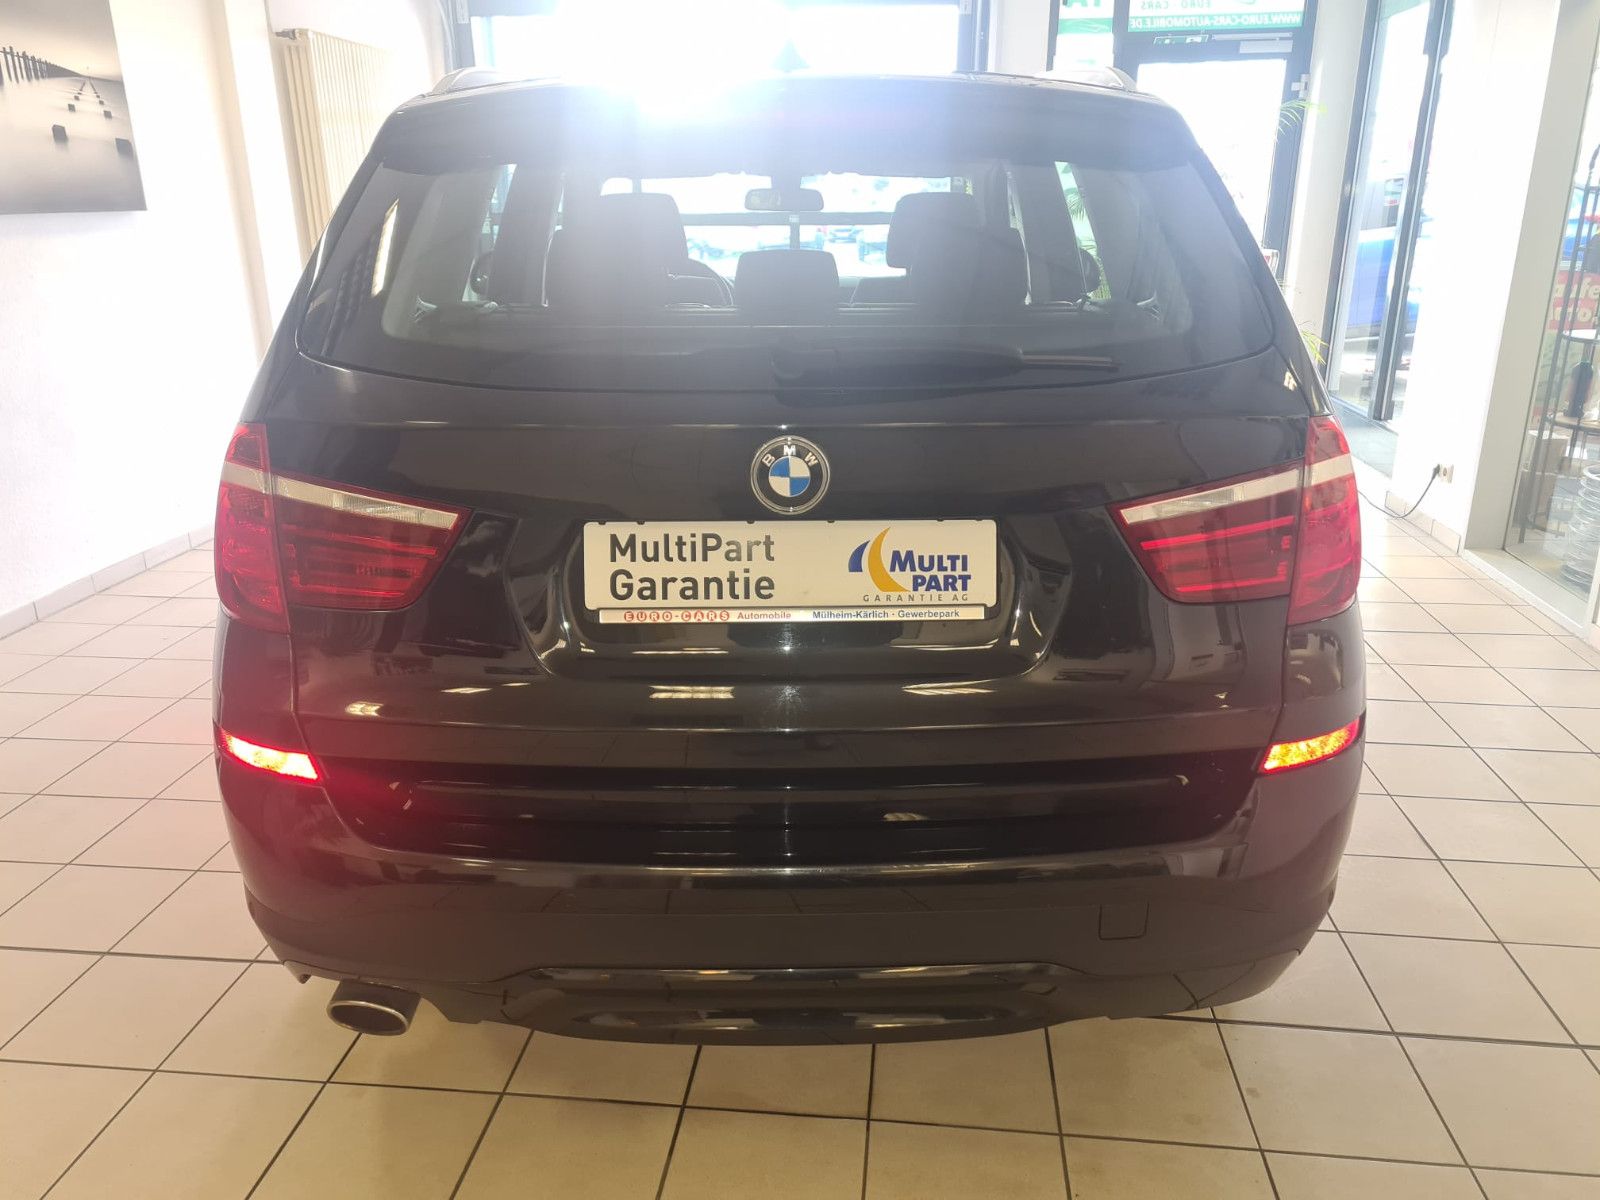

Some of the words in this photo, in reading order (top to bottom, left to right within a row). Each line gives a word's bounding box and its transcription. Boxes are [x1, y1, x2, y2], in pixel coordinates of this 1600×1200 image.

[761, 444, 819, 468] BMW
[609, 533, 775, 563] MultiPart
[889, 550, 968, 573] MULTI
[609, 568, 775, 601] Garantie
[912, 574, 972, 592] PART
[862, 593, 943, 602] GARANTIE
[952, 593, 969, 602] AG
[623, 610, 731, 622] EURO-CARS
[737, 610, 792, 620] Automobile
[812, 610, 889, 620] Mülheim-Kärlich
[897, 609, 960, 620] Gewerbepark
